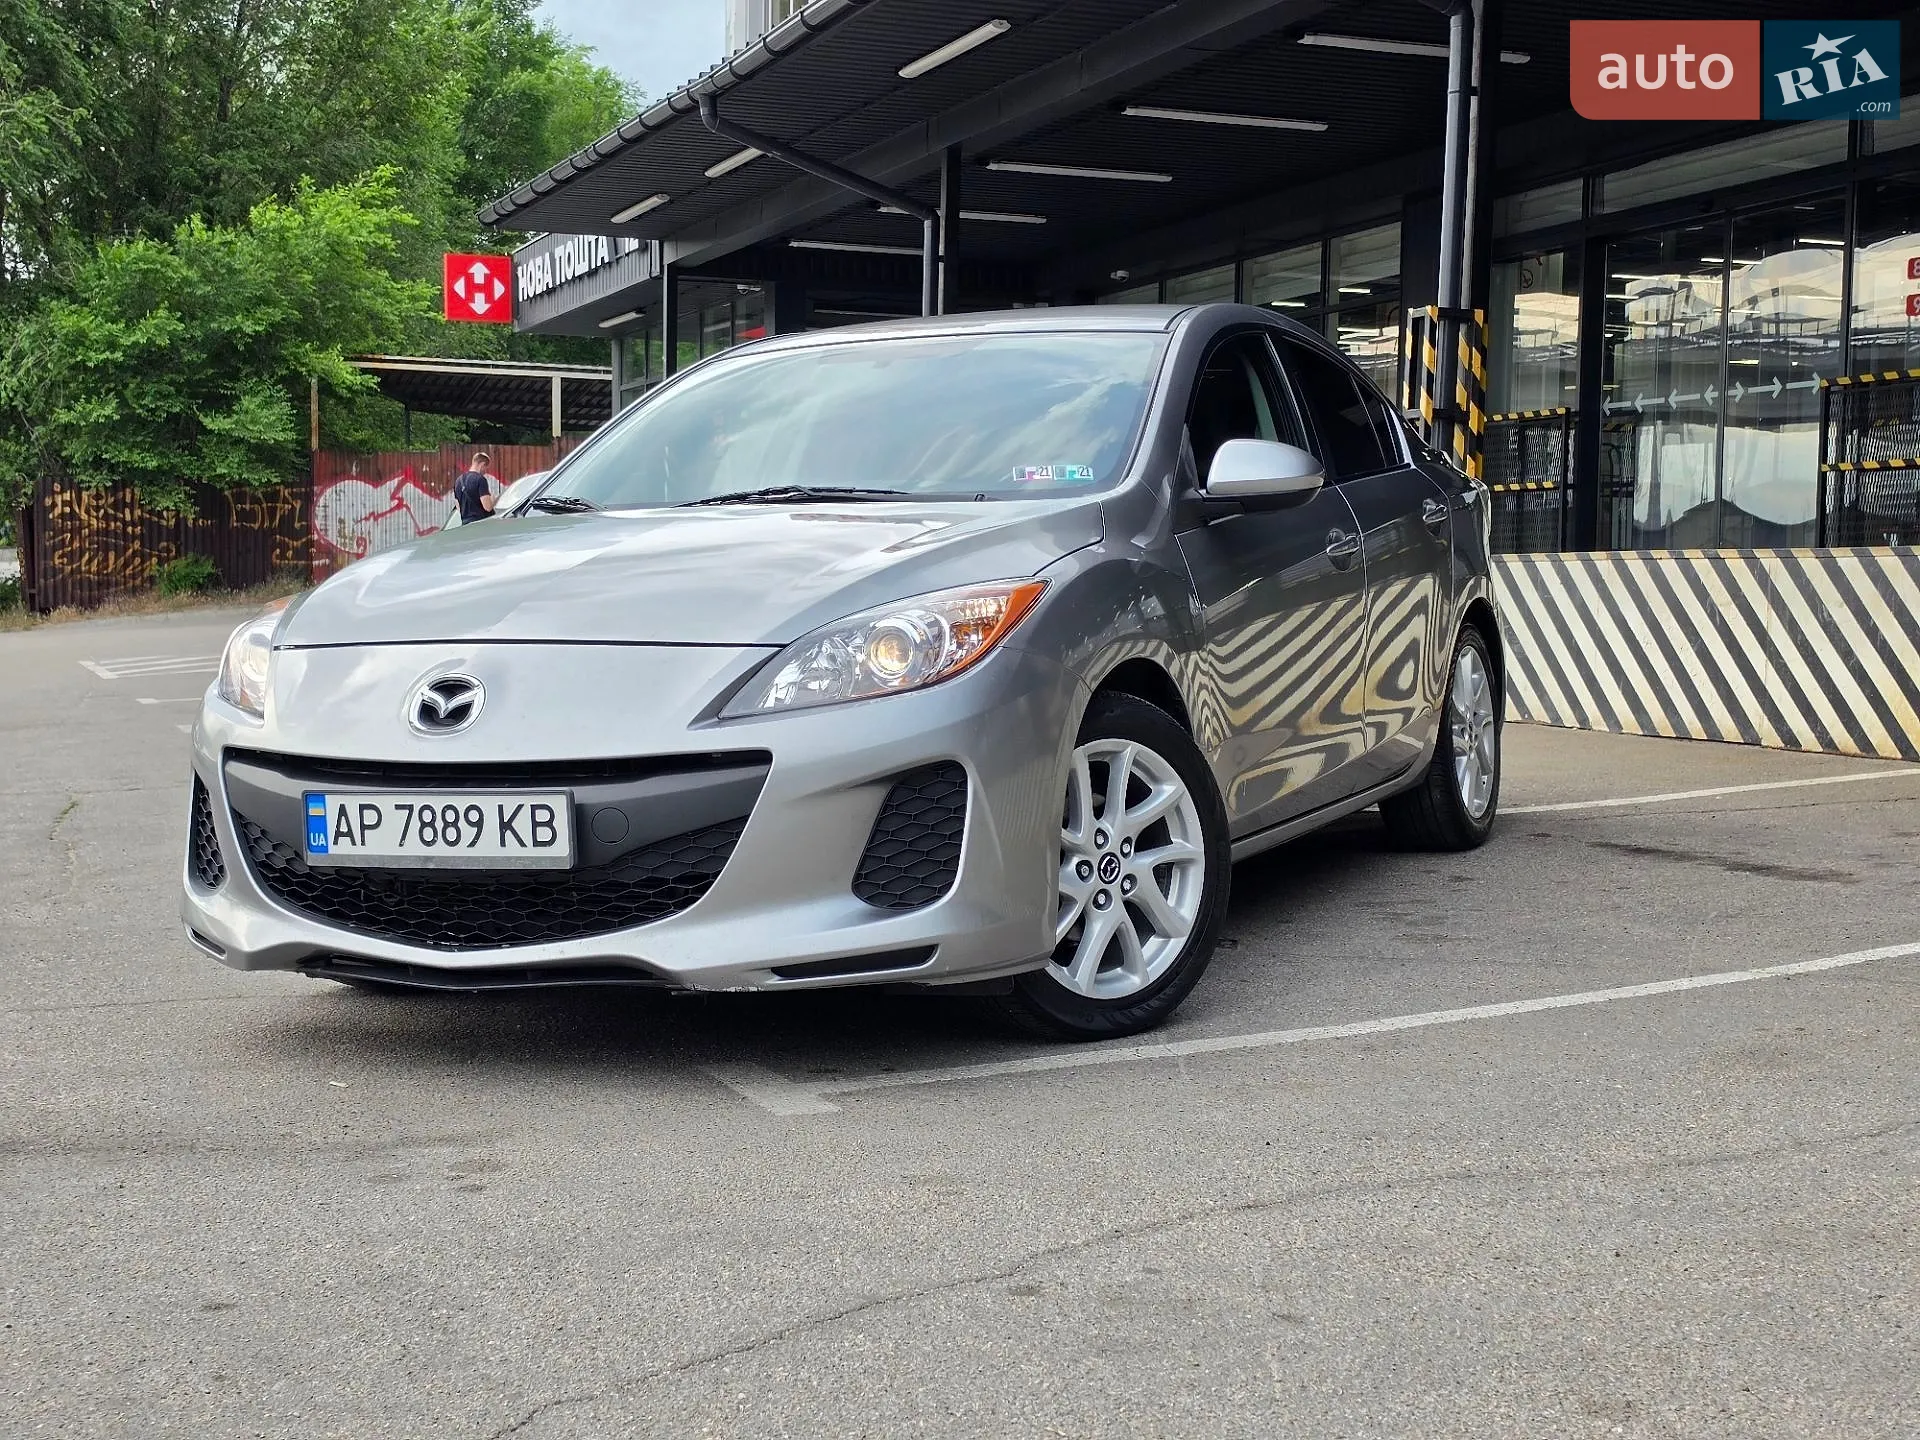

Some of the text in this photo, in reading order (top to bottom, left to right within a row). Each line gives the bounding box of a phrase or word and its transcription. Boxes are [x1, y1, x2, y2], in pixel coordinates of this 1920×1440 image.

[517, 235, 610, 302] НОВА ПОШТА
[310, 832, 327, 847] UA
[332, 803, 558, 848] AP 7889 KB
